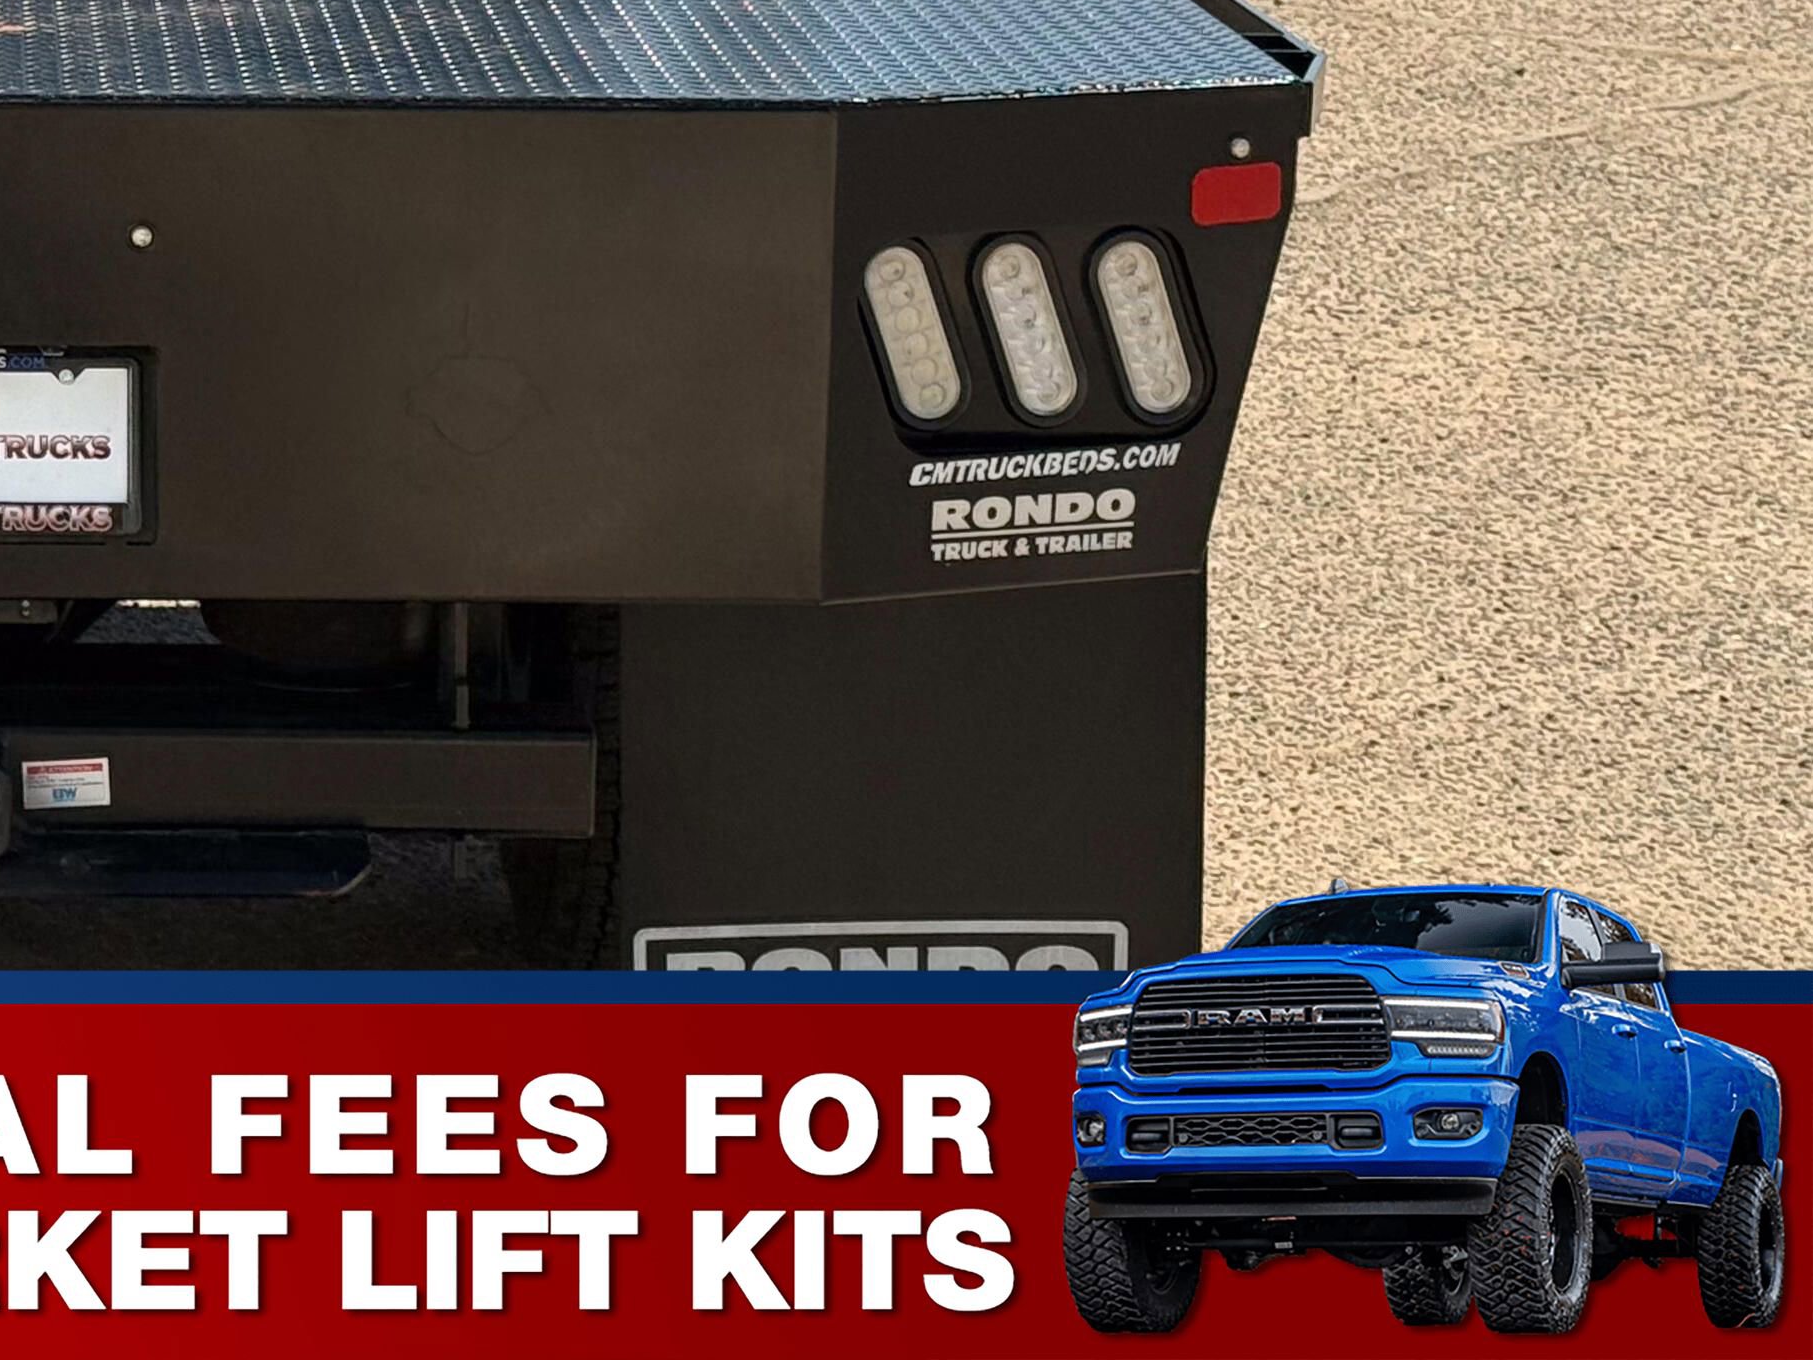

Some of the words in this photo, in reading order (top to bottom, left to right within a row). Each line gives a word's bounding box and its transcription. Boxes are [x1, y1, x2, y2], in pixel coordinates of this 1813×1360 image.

[909, 443, 1181, 487] CMTRUCKBEDS.COM
[931, 488, 1137, 531] RONDO
[931, 540, 1008, 562] TRUCK
[1014, 537, 1031, 557] &
[1035, 532, 1133, 555] TRAILER
